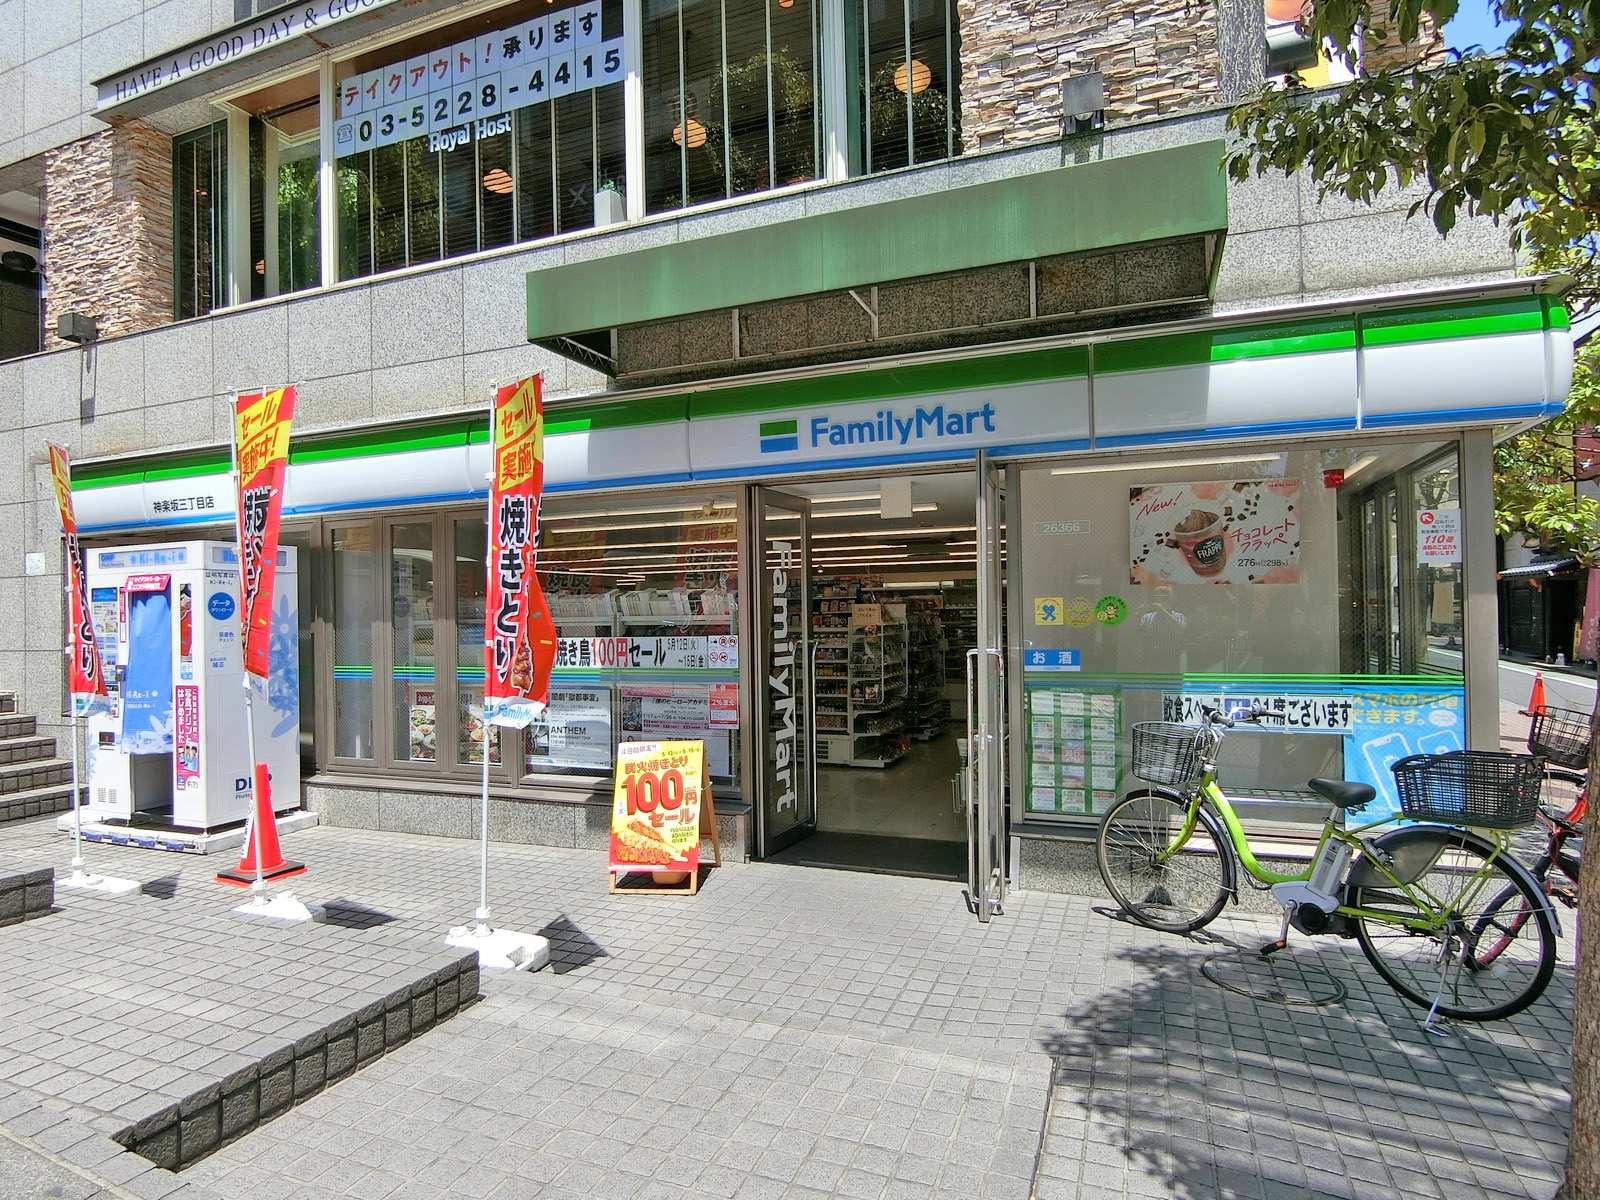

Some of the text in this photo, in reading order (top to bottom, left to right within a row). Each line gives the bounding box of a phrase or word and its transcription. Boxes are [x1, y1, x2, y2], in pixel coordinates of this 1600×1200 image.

[115, 66, 162, 102] HAVE
[169, 60, 181, 81] A
[188, 35, 244, 72] GOOD
[252, 15, 295, 49] DAY
[303, 7, 318, 29] &
[428, 112, 512, 153] Royal Host
[241, 396, 278, 441] セール
[502, 387, 533, 440] セール
[811, 402, 996, 448] FamilyMart
[153, 495, 214, 514] 神楽坂三丁目店
[1135, 491, 1183, 521] New!
[1042, 522, 1081, 534] 26366
[1231, 518, 1296, 542] チョコレート
[1240, 533, 1288, 553] フラッペ
[212, 599, 231, 607] データ
[1032, 651, 1072, 665] お酒
[769, 540, 797, 814] FamilyMart
[550, 726, 587, 735] ANTHEM
[624, 755, 688, 774] 炭火焼きとり
[648, 808, 696, 828] セール
